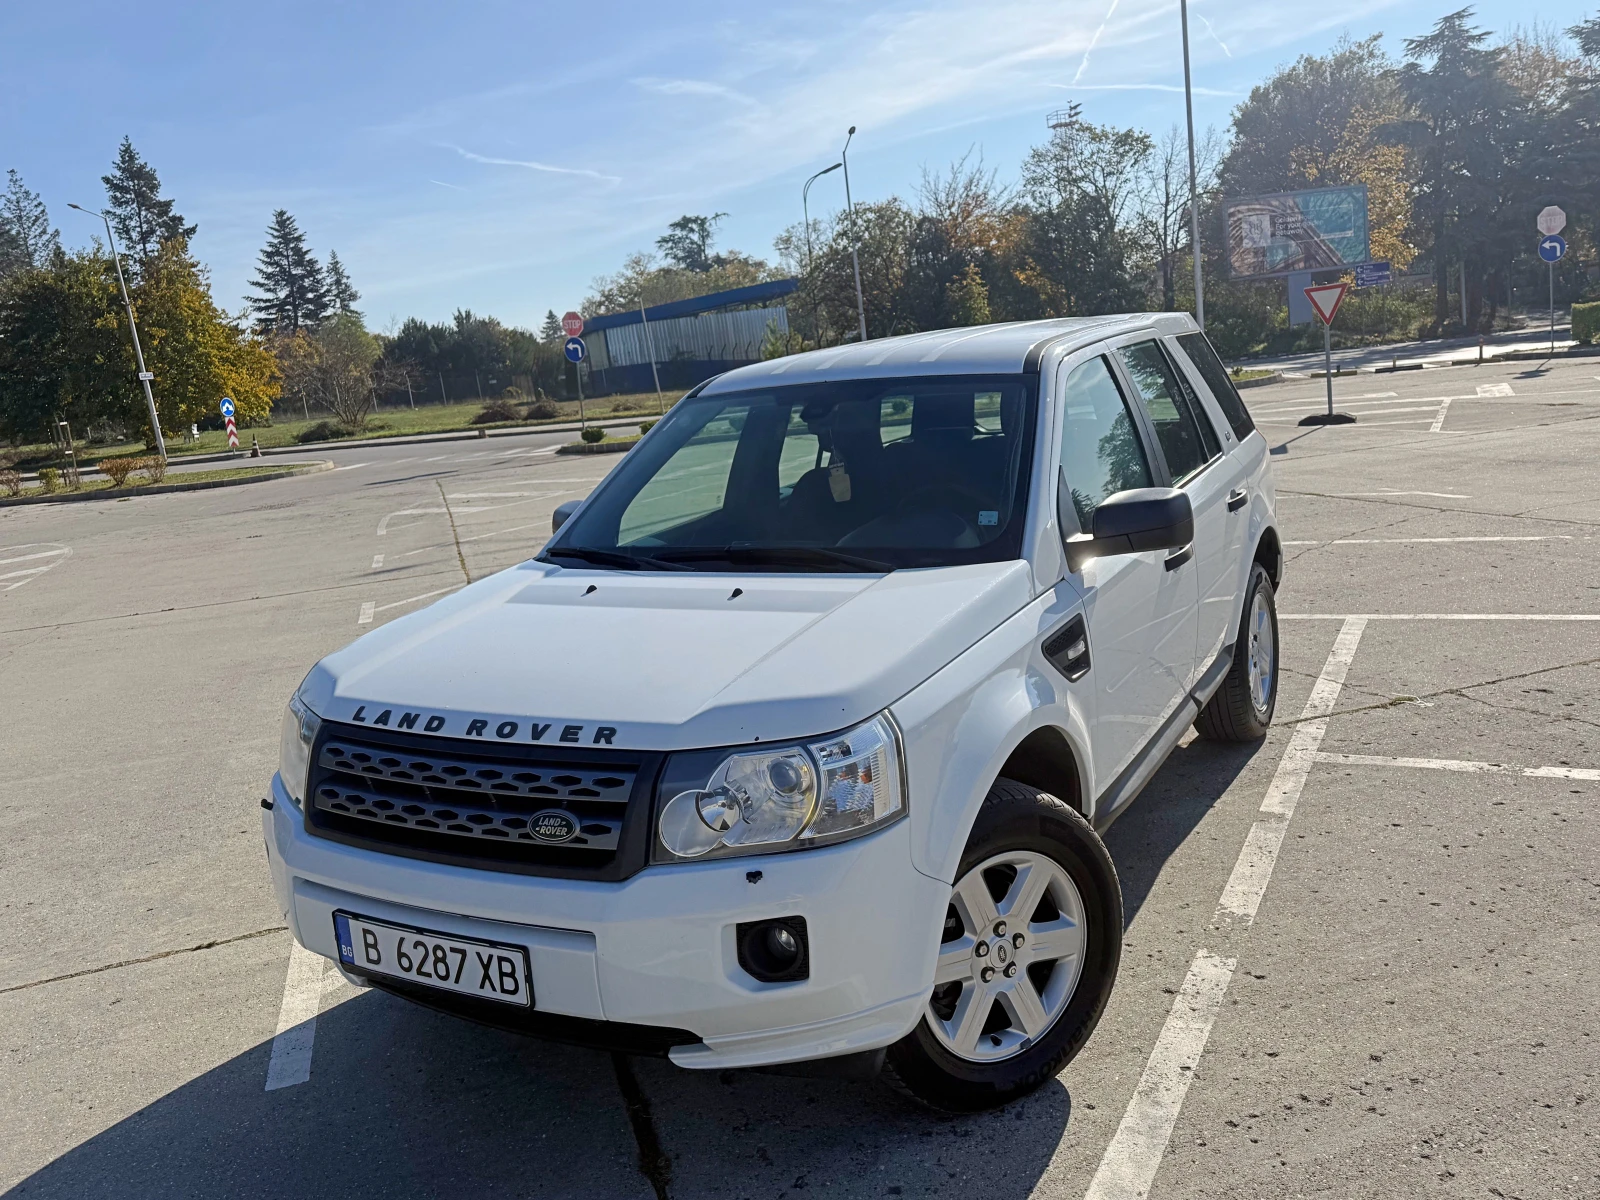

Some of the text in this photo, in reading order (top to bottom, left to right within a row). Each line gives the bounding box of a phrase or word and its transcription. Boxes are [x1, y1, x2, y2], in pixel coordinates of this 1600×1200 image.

[1286, 222, 1301, 230] your
[1540, 215, 1562, 227] STOP
[563, 320, 581, 329] STOP
[352, 705, 617, 745] LAND ROVER
[538, 817, 561, 827] LAND
[539, 825, 568, 836] ROVER
[341, 944, 353, 957] BG
[361, 927, 520, 996] B 6287 XB
